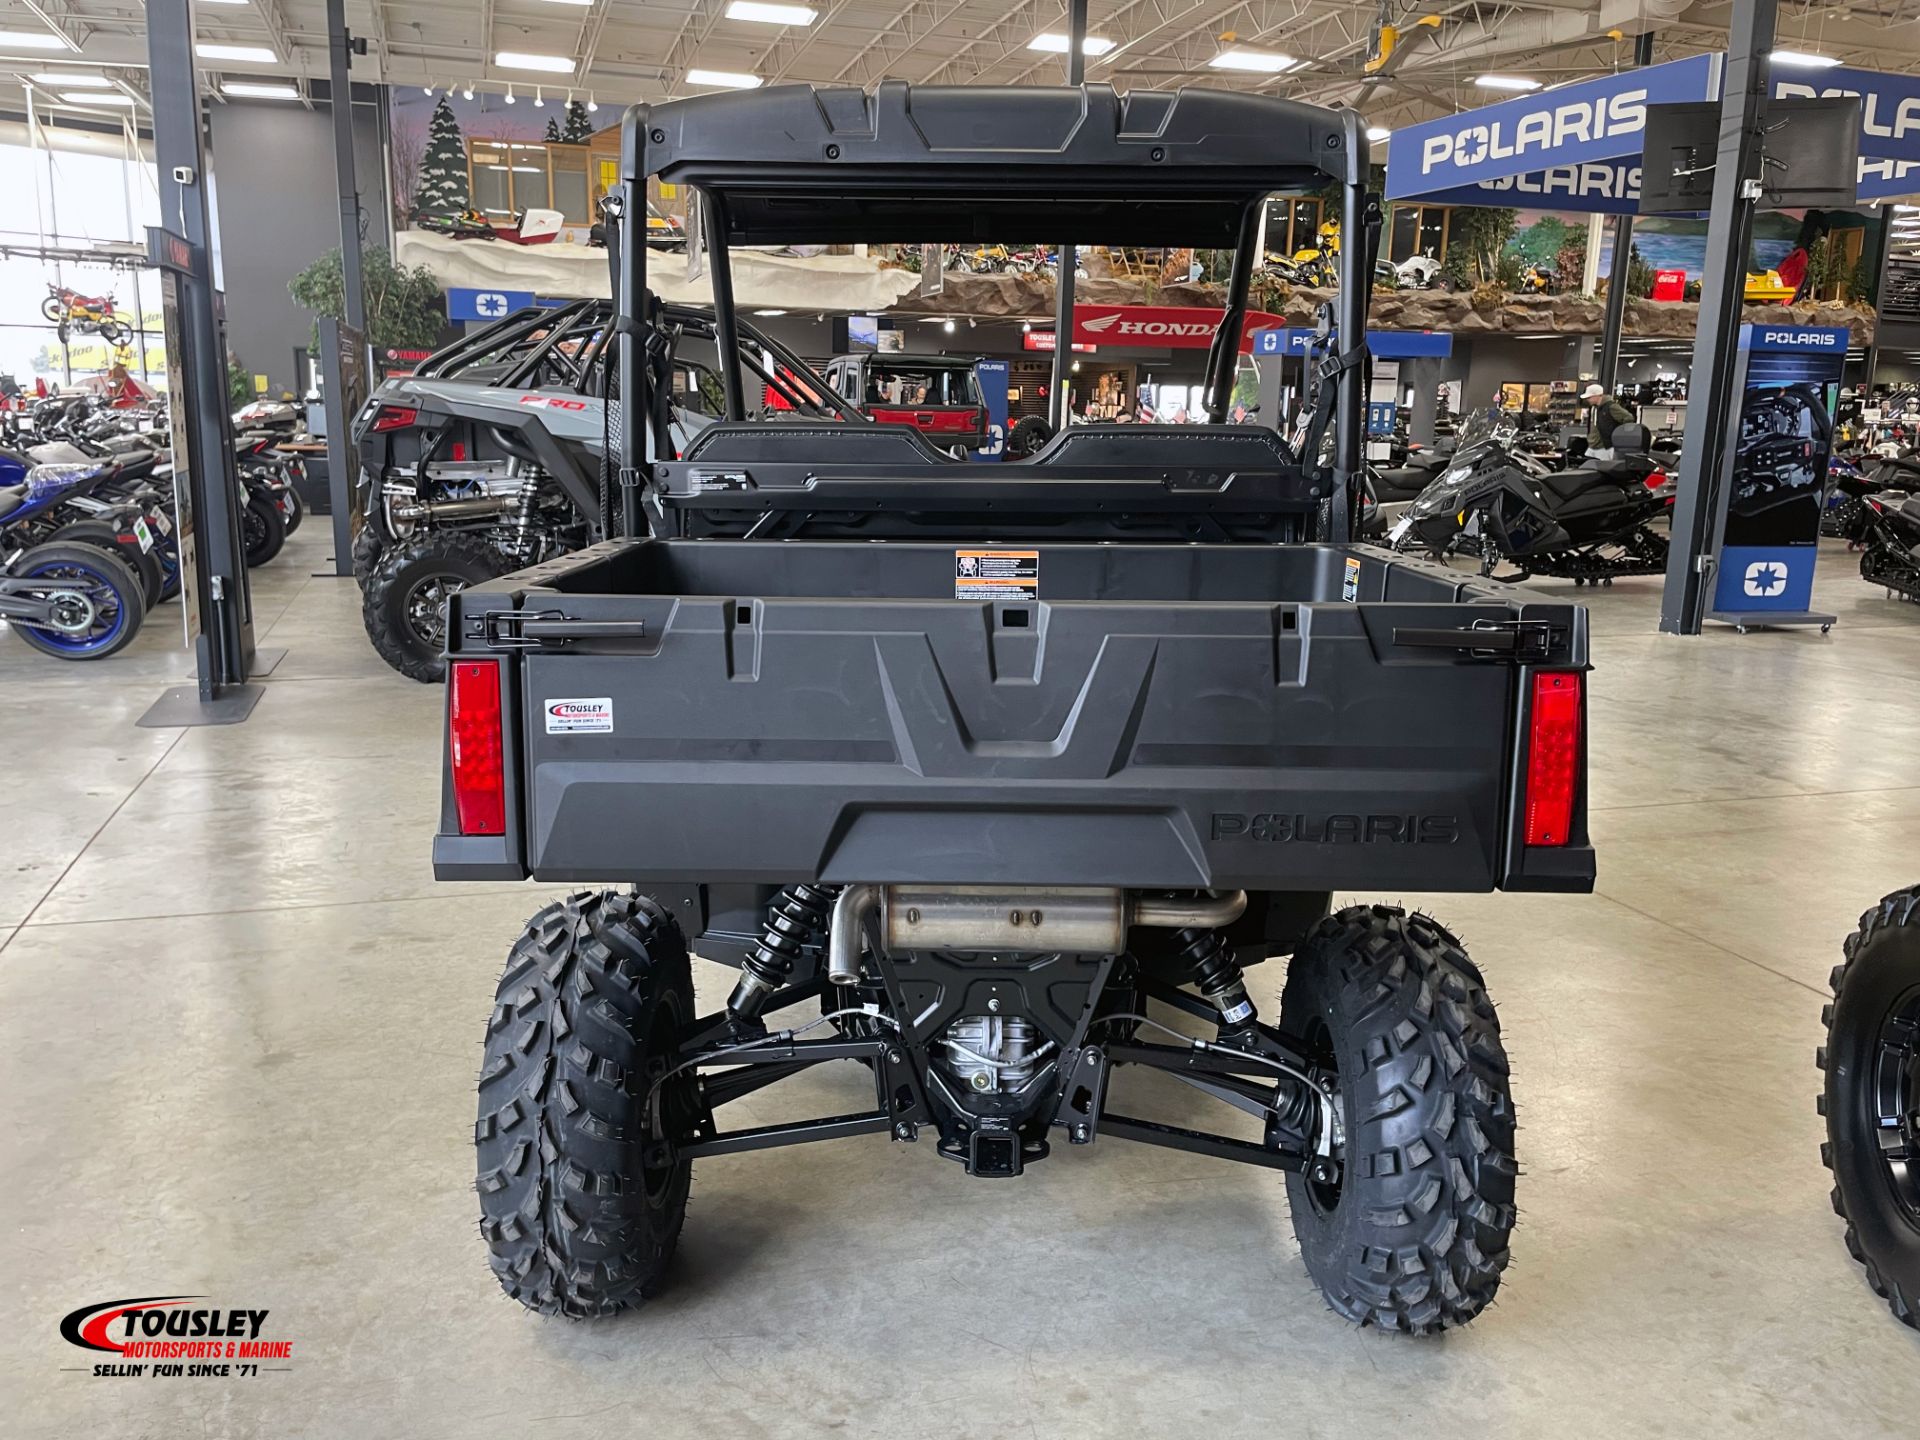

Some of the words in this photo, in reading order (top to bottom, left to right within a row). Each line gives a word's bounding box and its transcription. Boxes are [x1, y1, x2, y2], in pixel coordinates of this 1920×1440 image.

[1422, 89, 1648, 175] POLARIS
[1765, 332, 1835, 345] POLARIS
[564, 704, 604, 713] TOUSLEY
[1211, 813, 1460, 844] POLARIS
